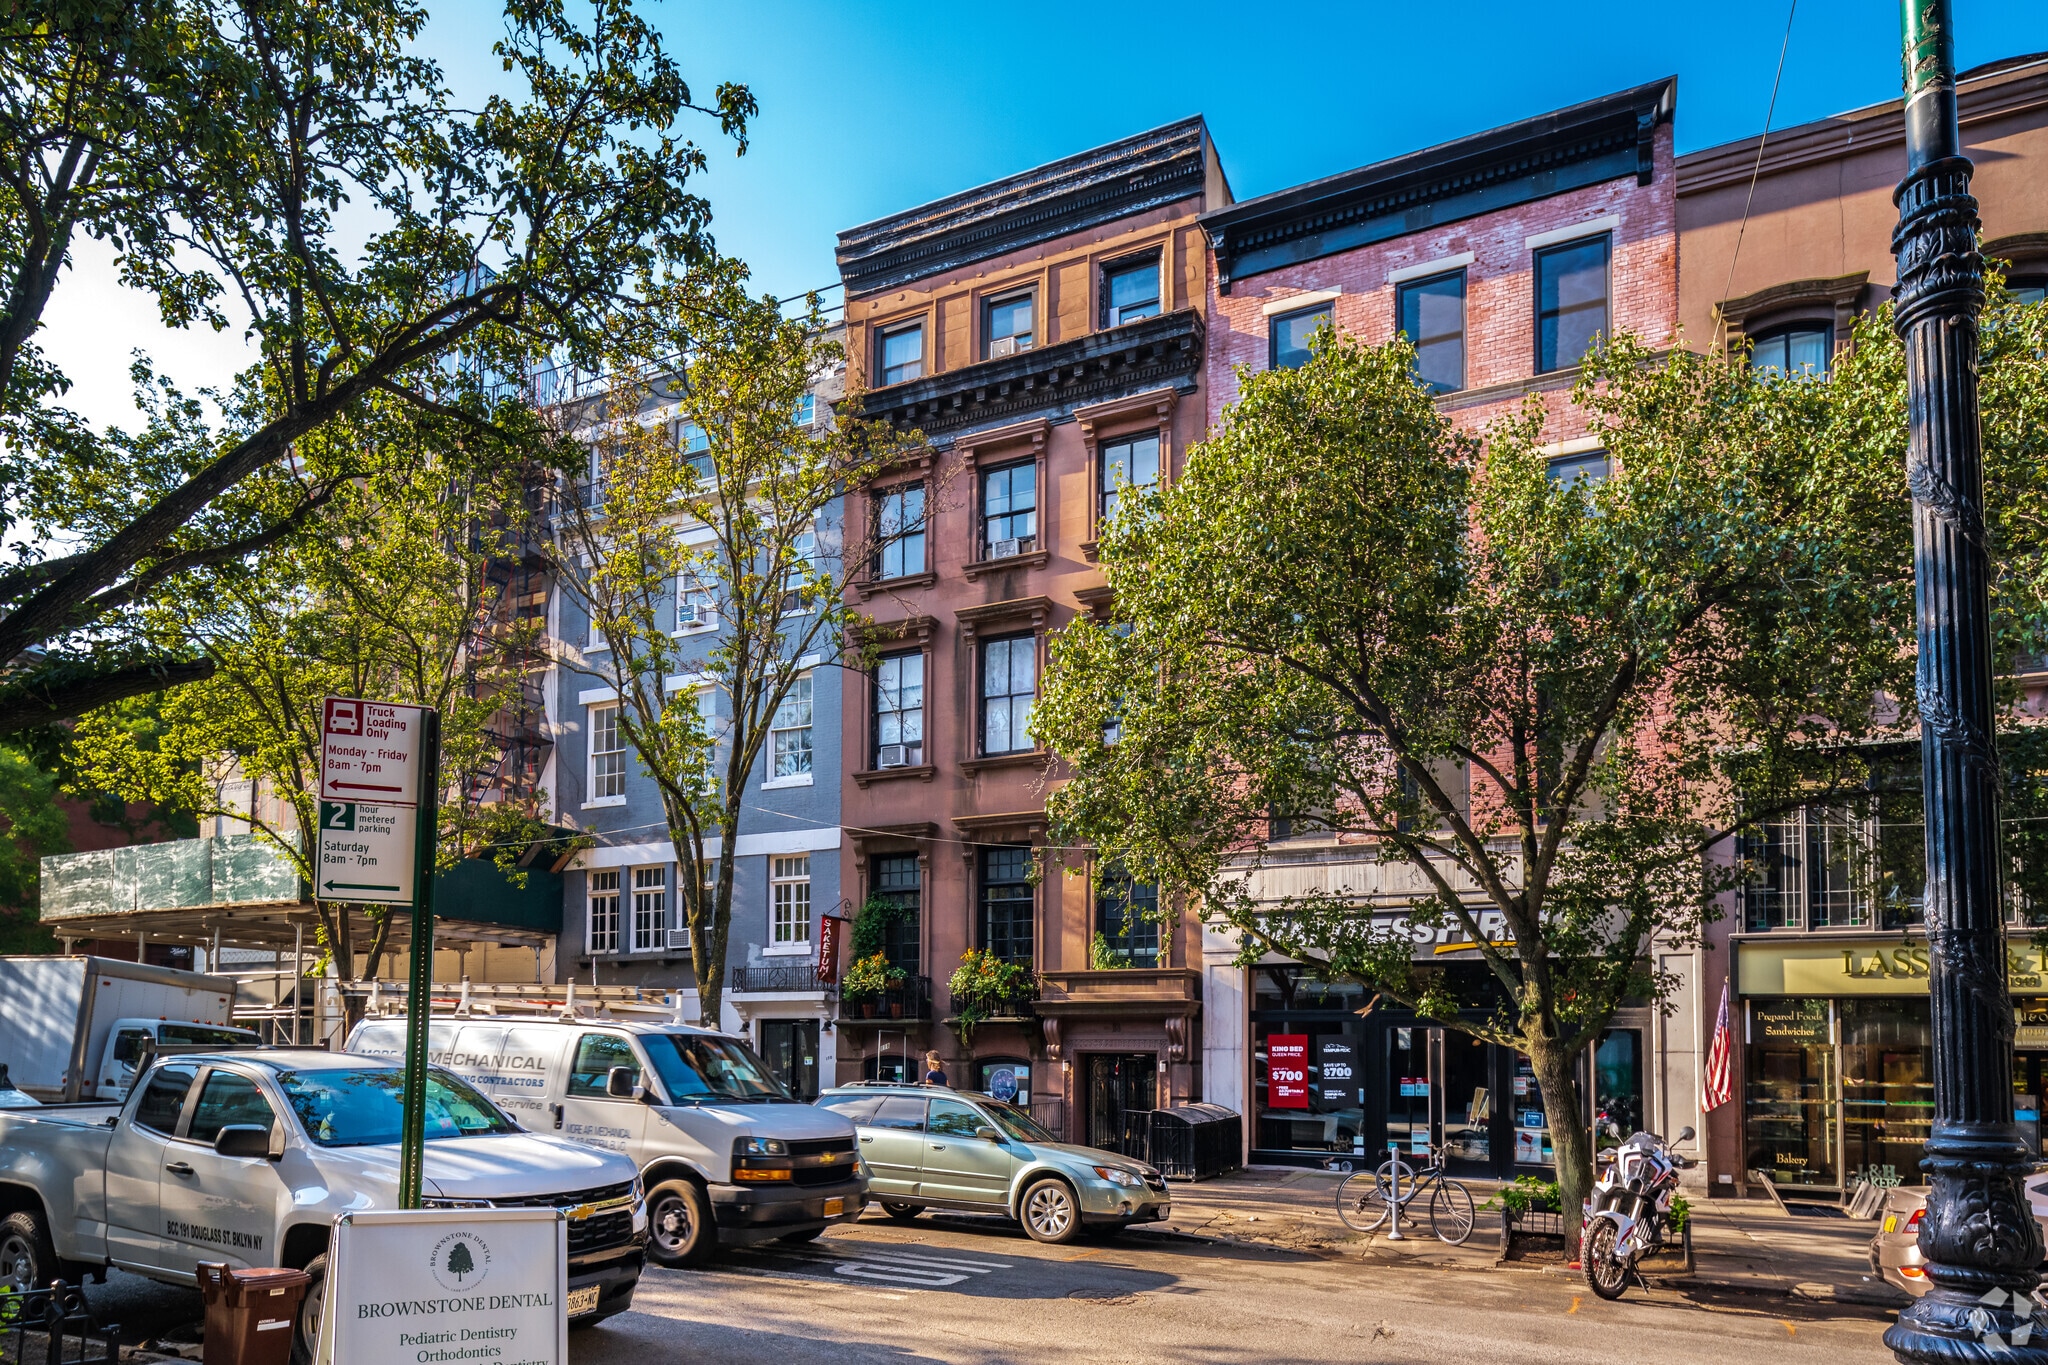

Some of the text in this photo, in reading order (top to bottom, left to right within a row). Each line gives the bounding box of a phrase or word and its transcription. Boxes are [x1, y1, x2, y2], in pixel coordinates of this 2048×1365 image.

[367, 706, 395, 718] Truck
[366, 718, 407, 732] Loading
[366, 727, 389, 740] Only
[328, 745, 367, 759] Monday
[377, 749, 408, 761] Friday
[328, 759, 351, 770] 8am
[361, 762, 382, 773] 7pm
[329, 803, 347, 827] 2
[359, 805, 379, 814] hour
[359, 815, 396, 825] metered
[358, 825, 391, 835] parking
[324, 841, 370, 854] Saturday
[323, 854, 346, 864] 8am
[356, 855, 378, 866] 7pm
[1757, 1010, 1823, 1022] Prepared Foods
[1765, 1025, 1815, 1036] Sandwiches
[428, 1052, 546, 1070] MECHANICAL
[1272, 1071, 1303, 1080] $700
[1324, 1068, 1352, 1076] $700
[477, 1076, 545, 1088] CONTRACTORS
[500, 1098, 544, 1110] Service
[1776, 1153, 1808, 1166] Bakery
[167, 1221, 263, 1251] BCC 191 DOUGLASS ST. BKLYN NY
[430, 1232, 492, 1267] BROWNSTONE DENTAL
[357, 1293, 553, 1319] BROWNSTONE DENTAL
[400, 1326, 518, 1346] Pediatric Dentistry
[417, 1345, 502, 1363] Orthodontics
